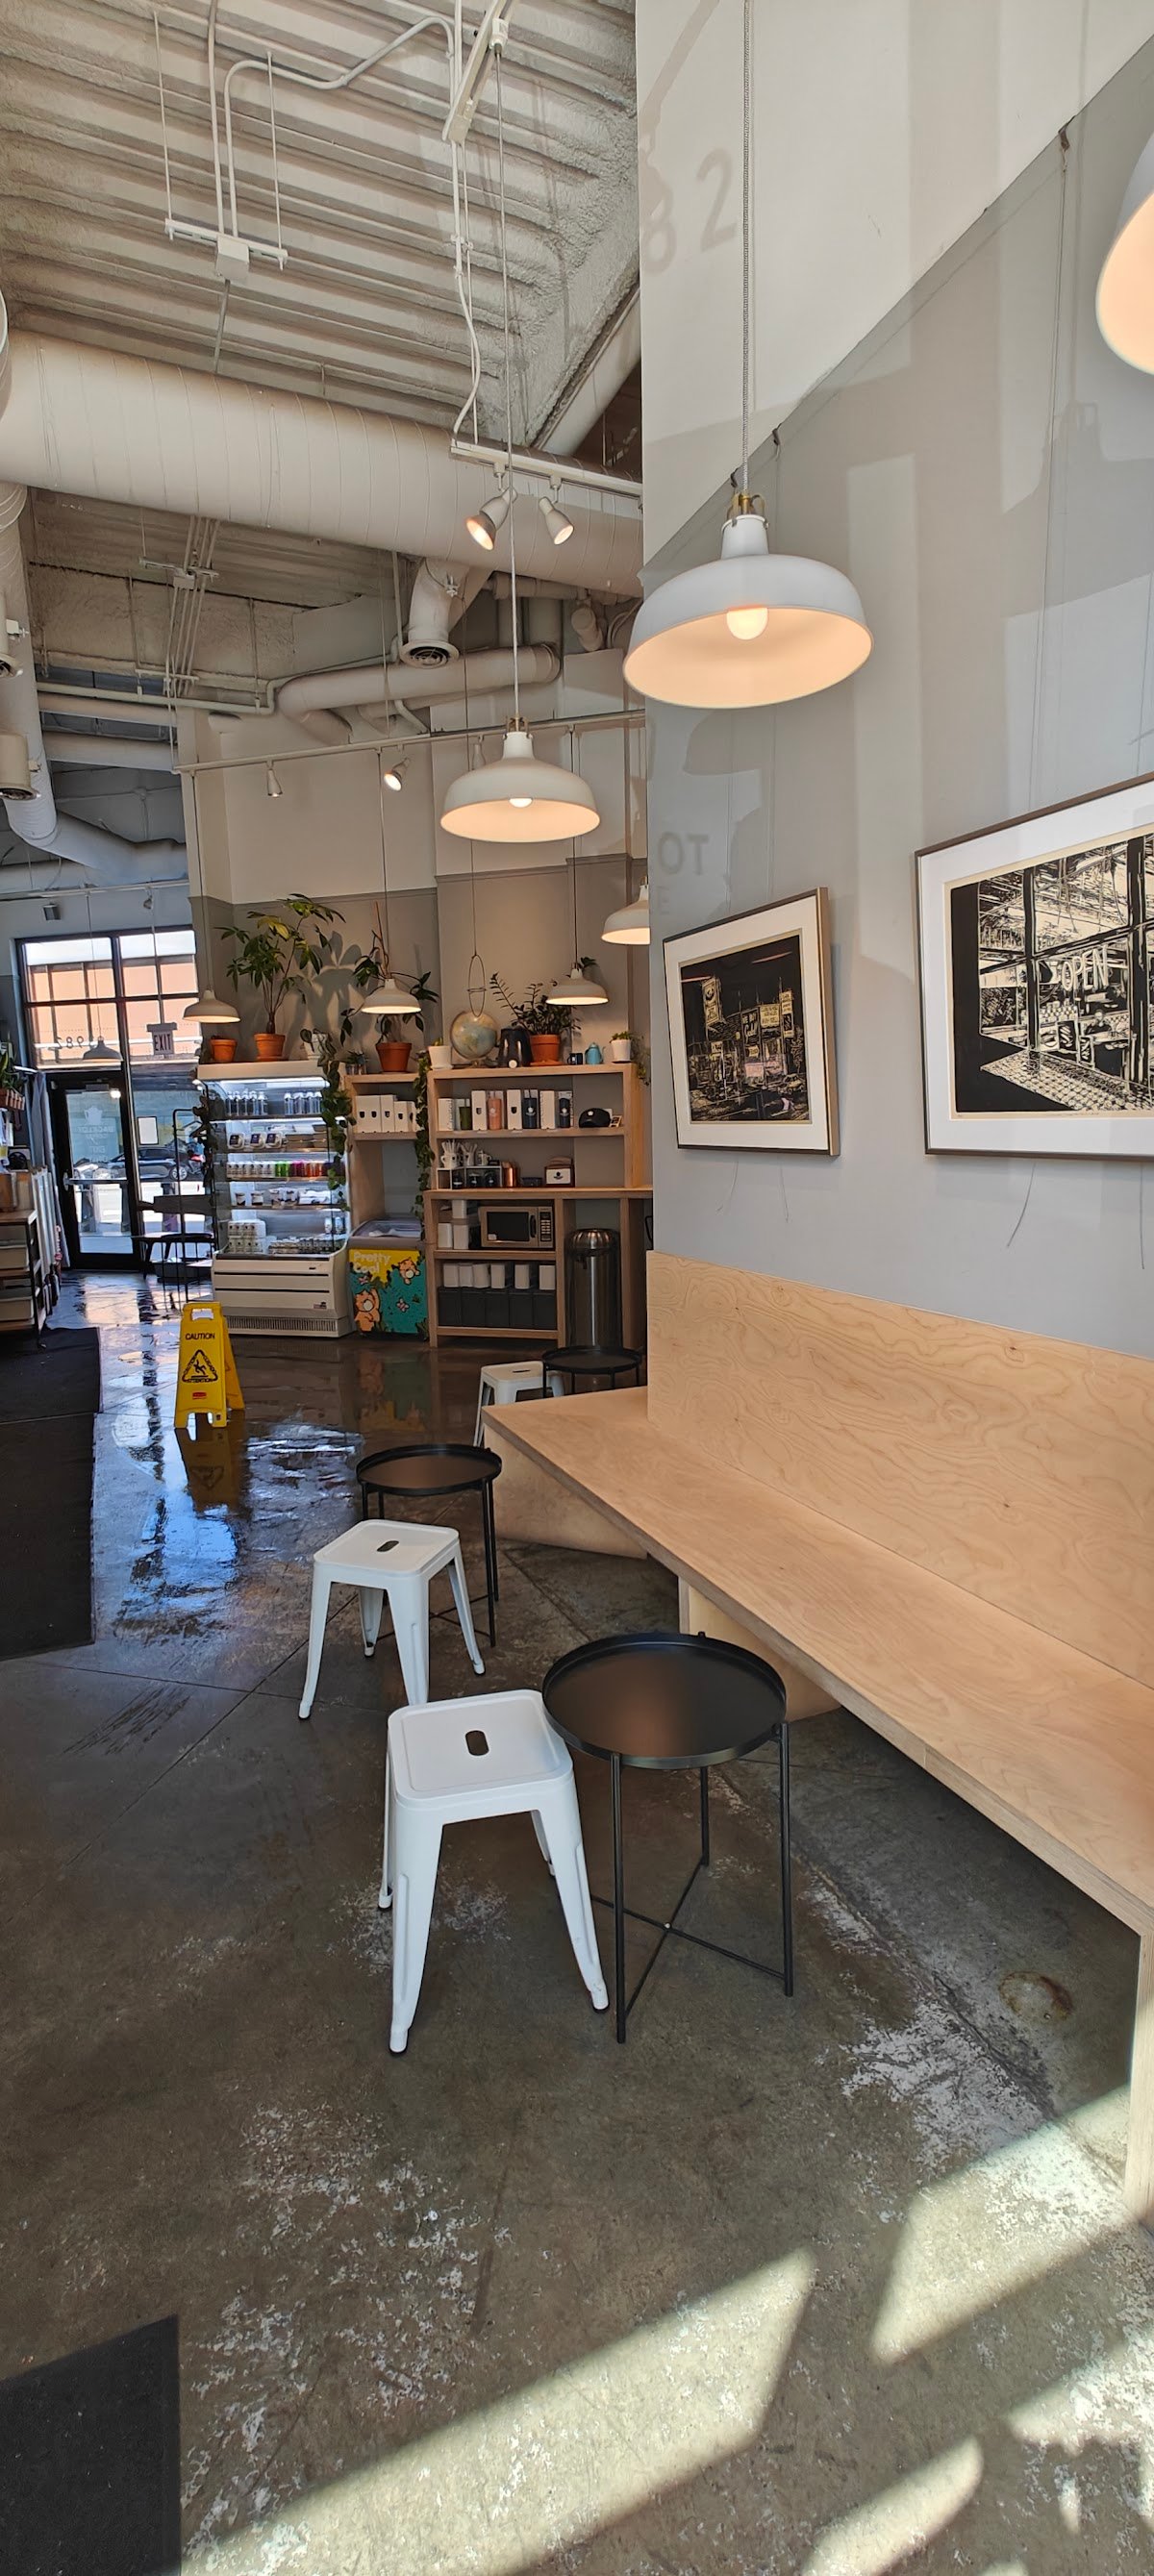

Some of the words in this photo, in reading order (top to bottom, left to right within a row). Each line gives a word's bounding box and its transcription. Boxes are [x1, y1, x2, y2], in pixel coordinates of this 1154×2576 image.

[1062, 944, 1109, 991] OPEN
[154, 1033, 171, 1051] EXIT
[354, 1251, 391, 1265] Pretty
[353, 1262, 380, 1273] Cool
